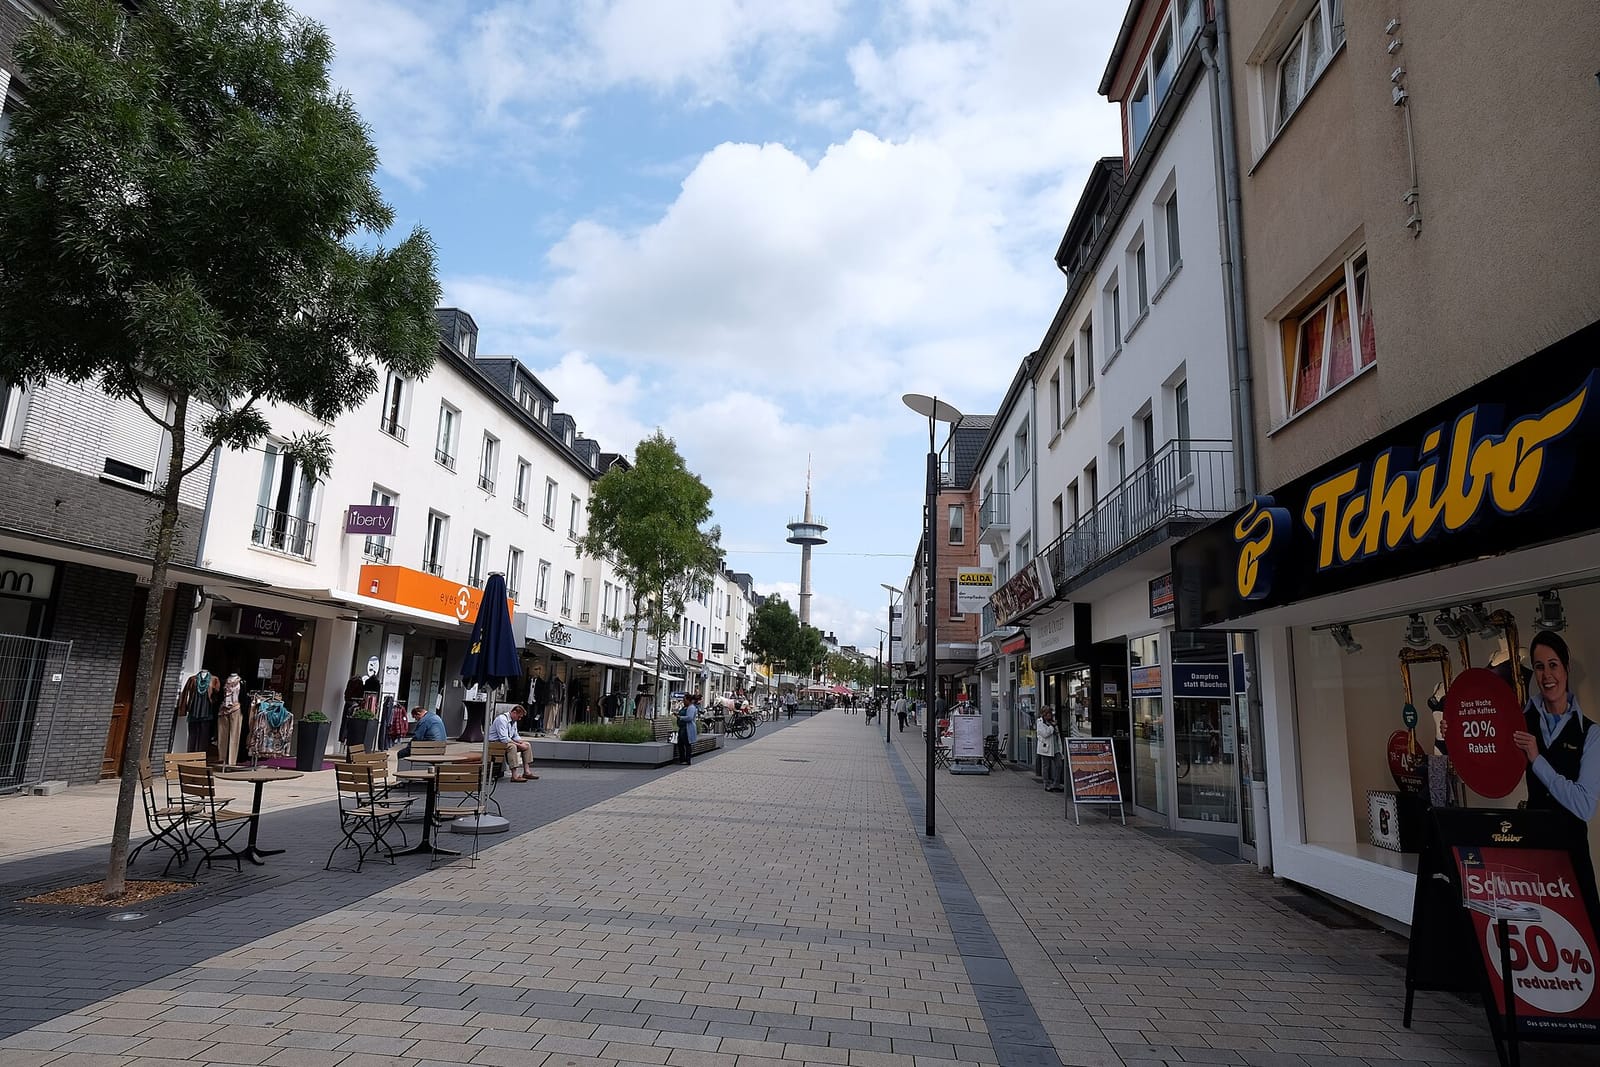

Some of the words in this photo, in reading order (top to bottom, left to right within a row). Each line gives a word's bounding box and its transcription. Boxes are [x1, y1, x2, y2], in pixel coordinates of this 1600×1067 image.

[1303, 386, 1588, 570] Tchibo
[349, 511, 391, 530] liberty
[960, 574, 991, 582] CALIDA
[440, 593, 457, 607] eyes
[254, 613, 282, 634] liberty
[1475, 699, 1492, 707] Woche
[1462, 720, 1496, 738] 20%
[1469, 743, 1496, 754] Rabatt
[1492, 833, 1523, 843] Tchibo
[1467, 874, 1575, 898] Schmuck
[1516, 976, 1583, 991] reduziert
